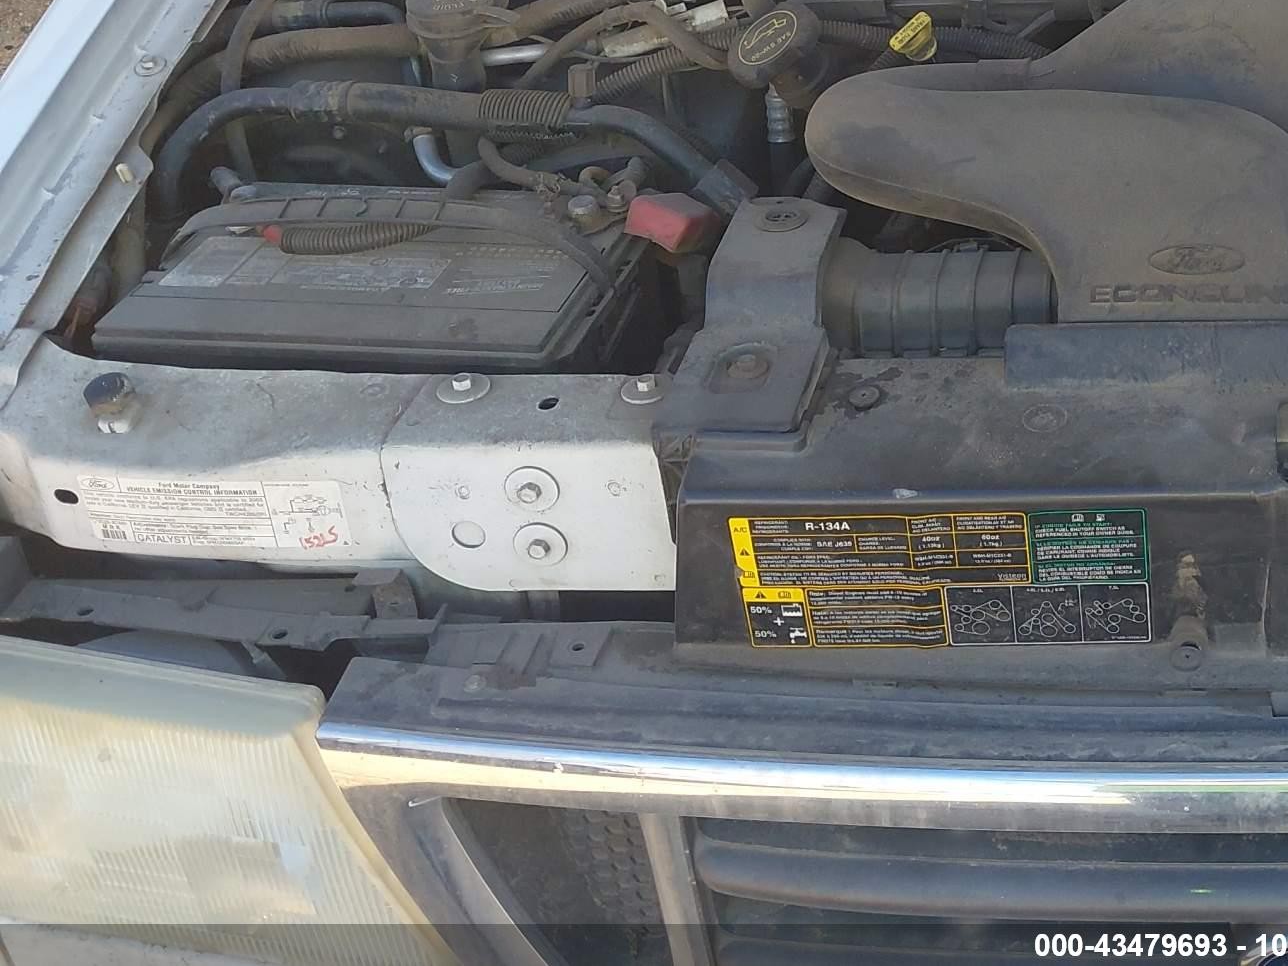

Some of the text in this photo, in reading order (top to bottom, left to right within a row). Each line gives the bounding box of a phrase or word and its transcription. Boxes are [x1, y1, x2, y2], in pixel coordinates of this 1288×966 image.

[191, 483, 220, 492] Company
[733, 526, 748, 534] A/C
[804, 521, 851, 532] R-134A
[137, 533, 187, 544] CATALYST
[996, 572, 1027, 581] Visteon
[750, 605, 773, 614] 50%
[754, 630, 777, 638] 50%
